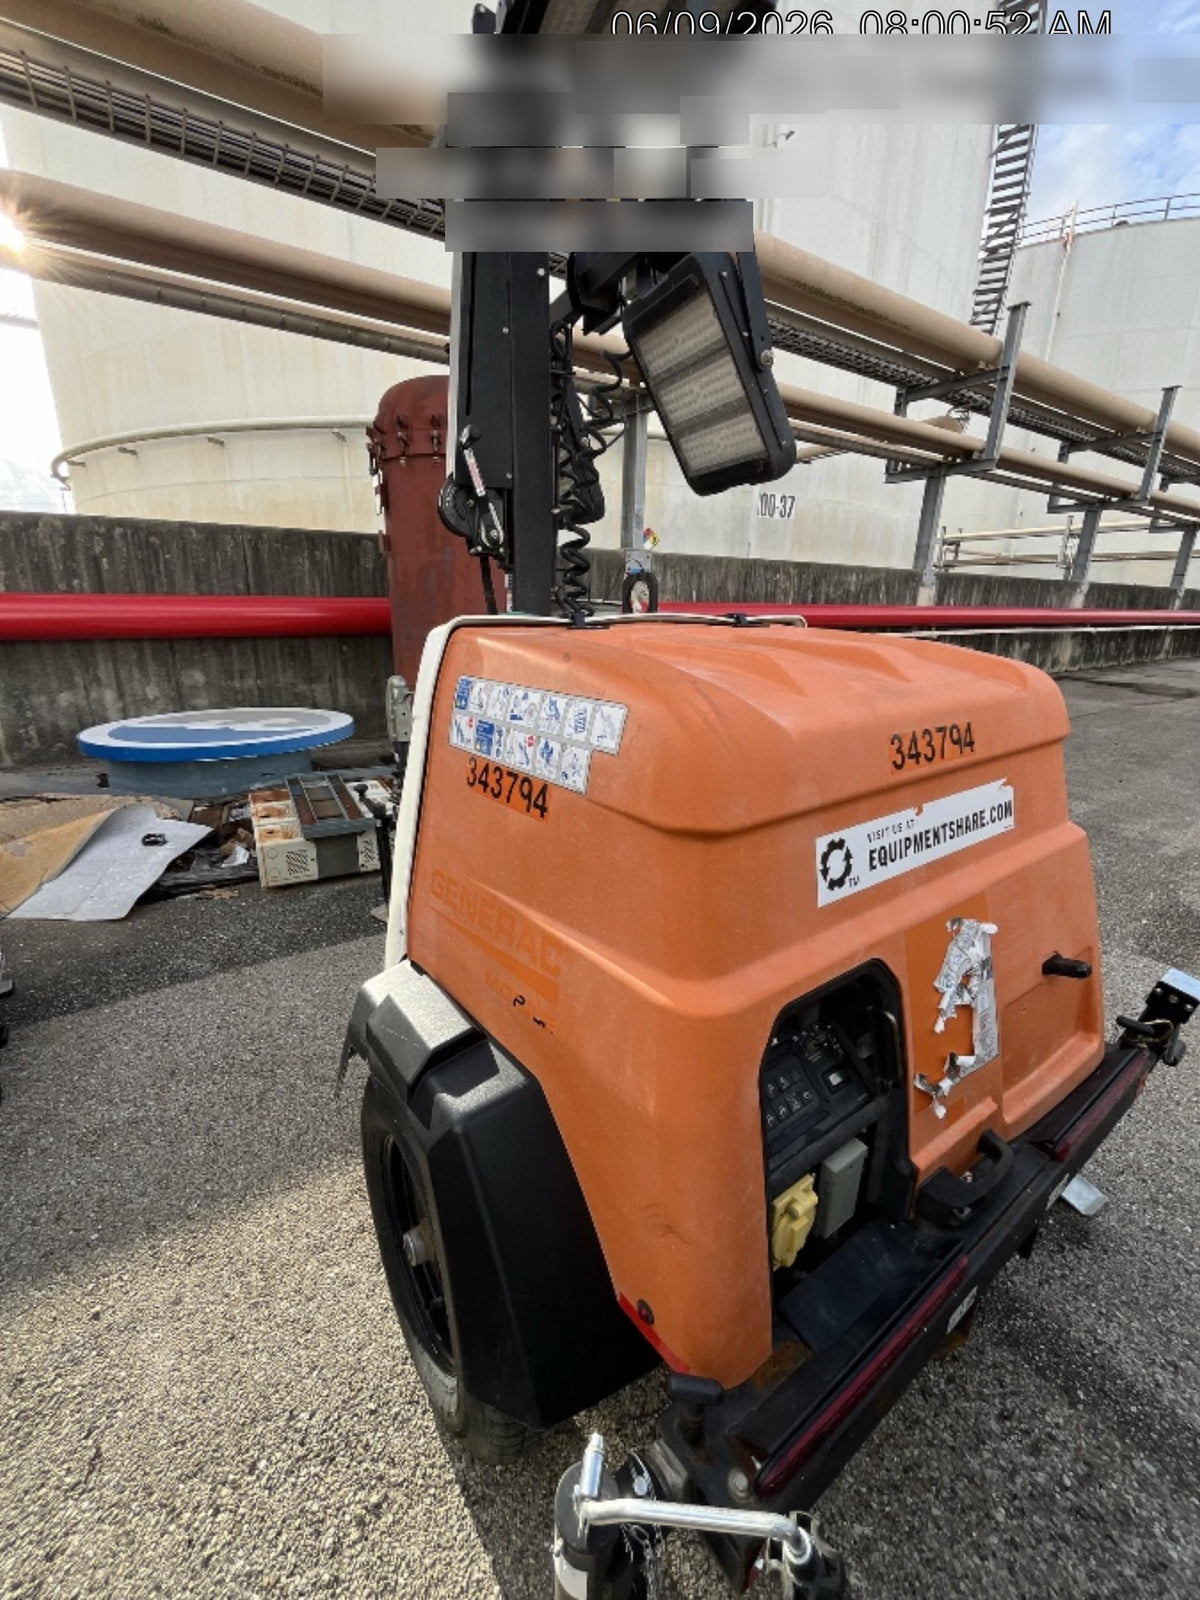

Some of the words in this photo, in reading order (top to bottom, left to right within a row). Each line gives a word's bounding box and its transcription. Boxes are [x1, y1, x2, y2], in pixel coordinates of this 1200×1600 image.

[890, 722, 975, 770] 343794
[467, 756, 549, 818] 343794
[867, 826, 889, 843] VISIT
[868, 800, 1013, 872] EQUIPMENTSHARE.COM
[430, 867, 565, 977] GENERAC
